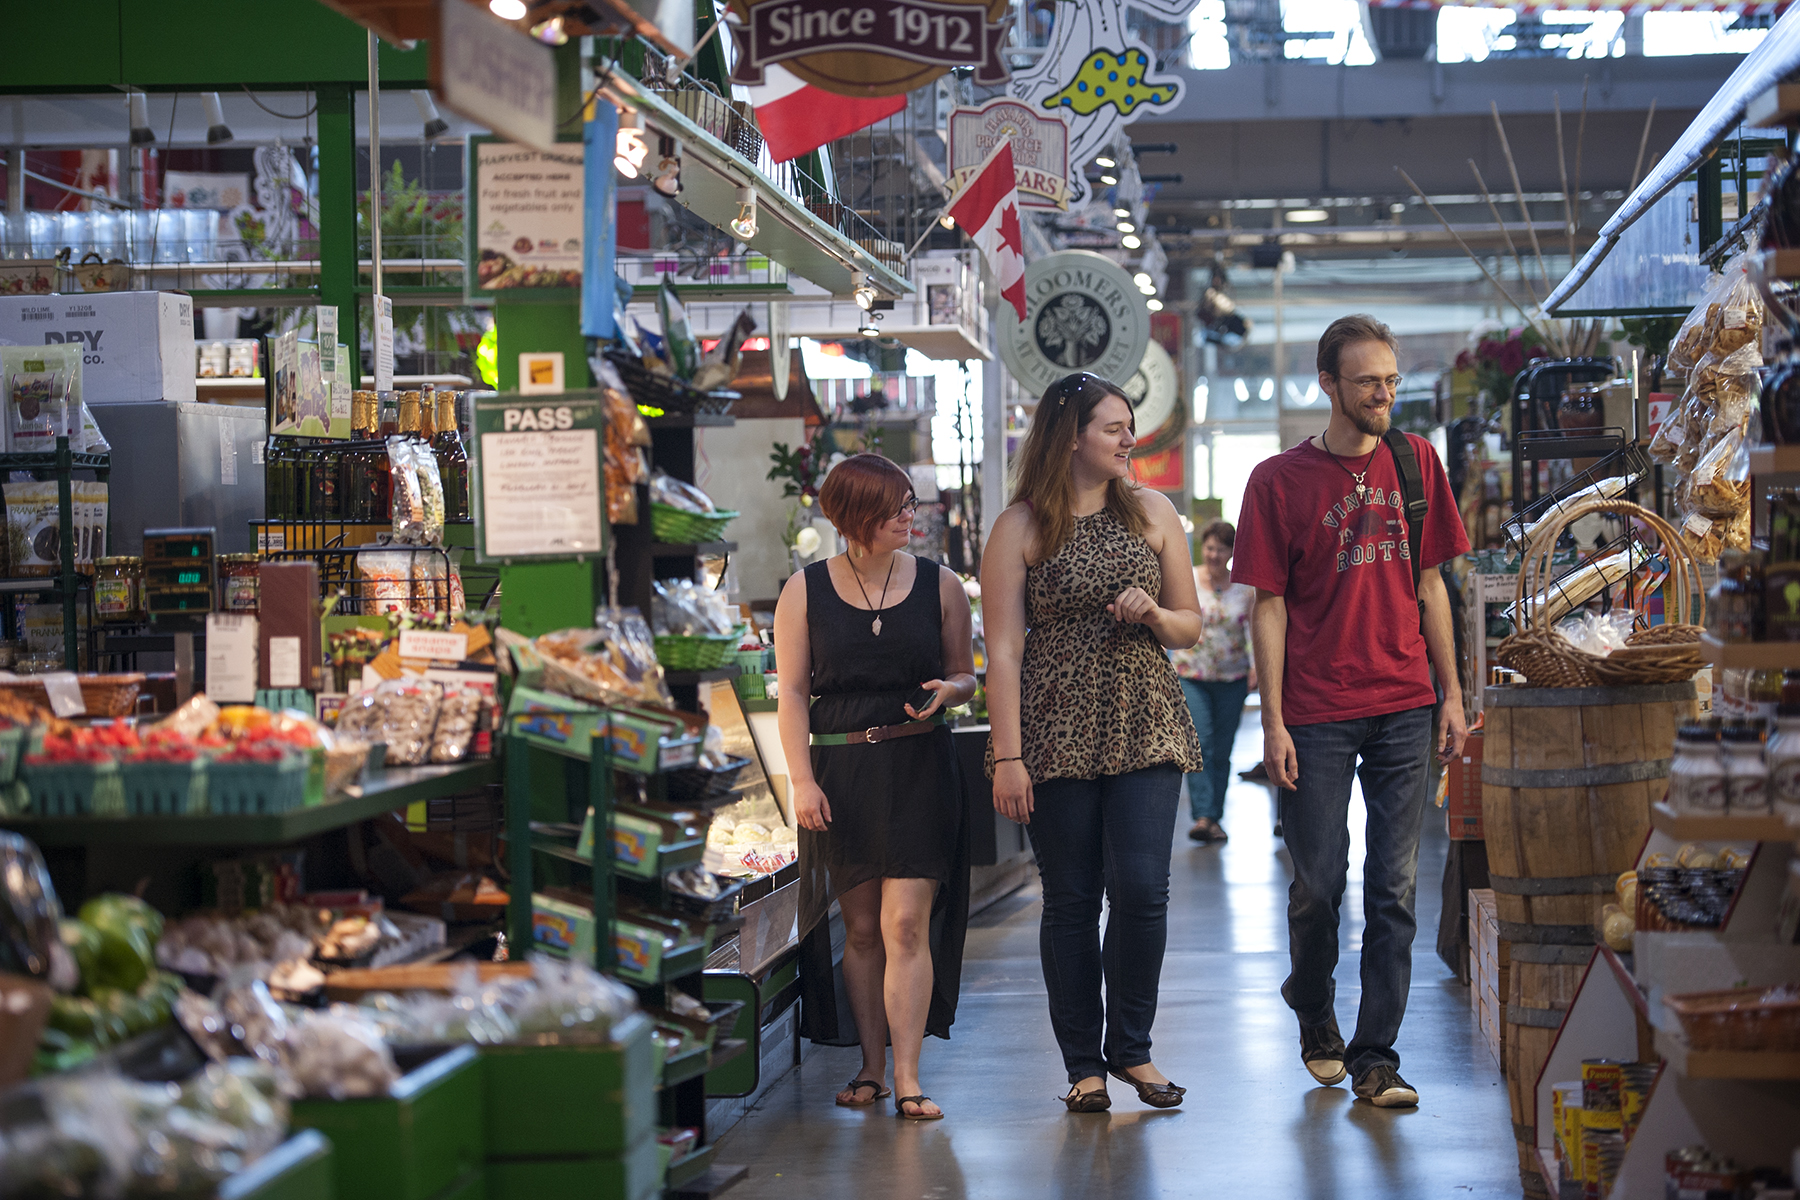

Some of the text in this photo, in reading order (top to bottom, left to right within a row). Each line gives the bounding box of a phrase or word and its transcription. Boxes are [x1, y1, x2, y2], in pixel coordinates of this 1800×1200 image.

[768, 5, 974, 53] Since 1912
[482, 188, 580, 198] For fresh fruit and
[489, 203, 547, 214] vegetables
[504, 407, 574, 431] PASS
[11, 506, 36, 515] PRANA
[1337, 540, 1410, 573] ROOTS
[30, 628, 60, 637] PRANA
[406, 636, 458, 646] sesame
[411, 645, 452, 655] snaps
